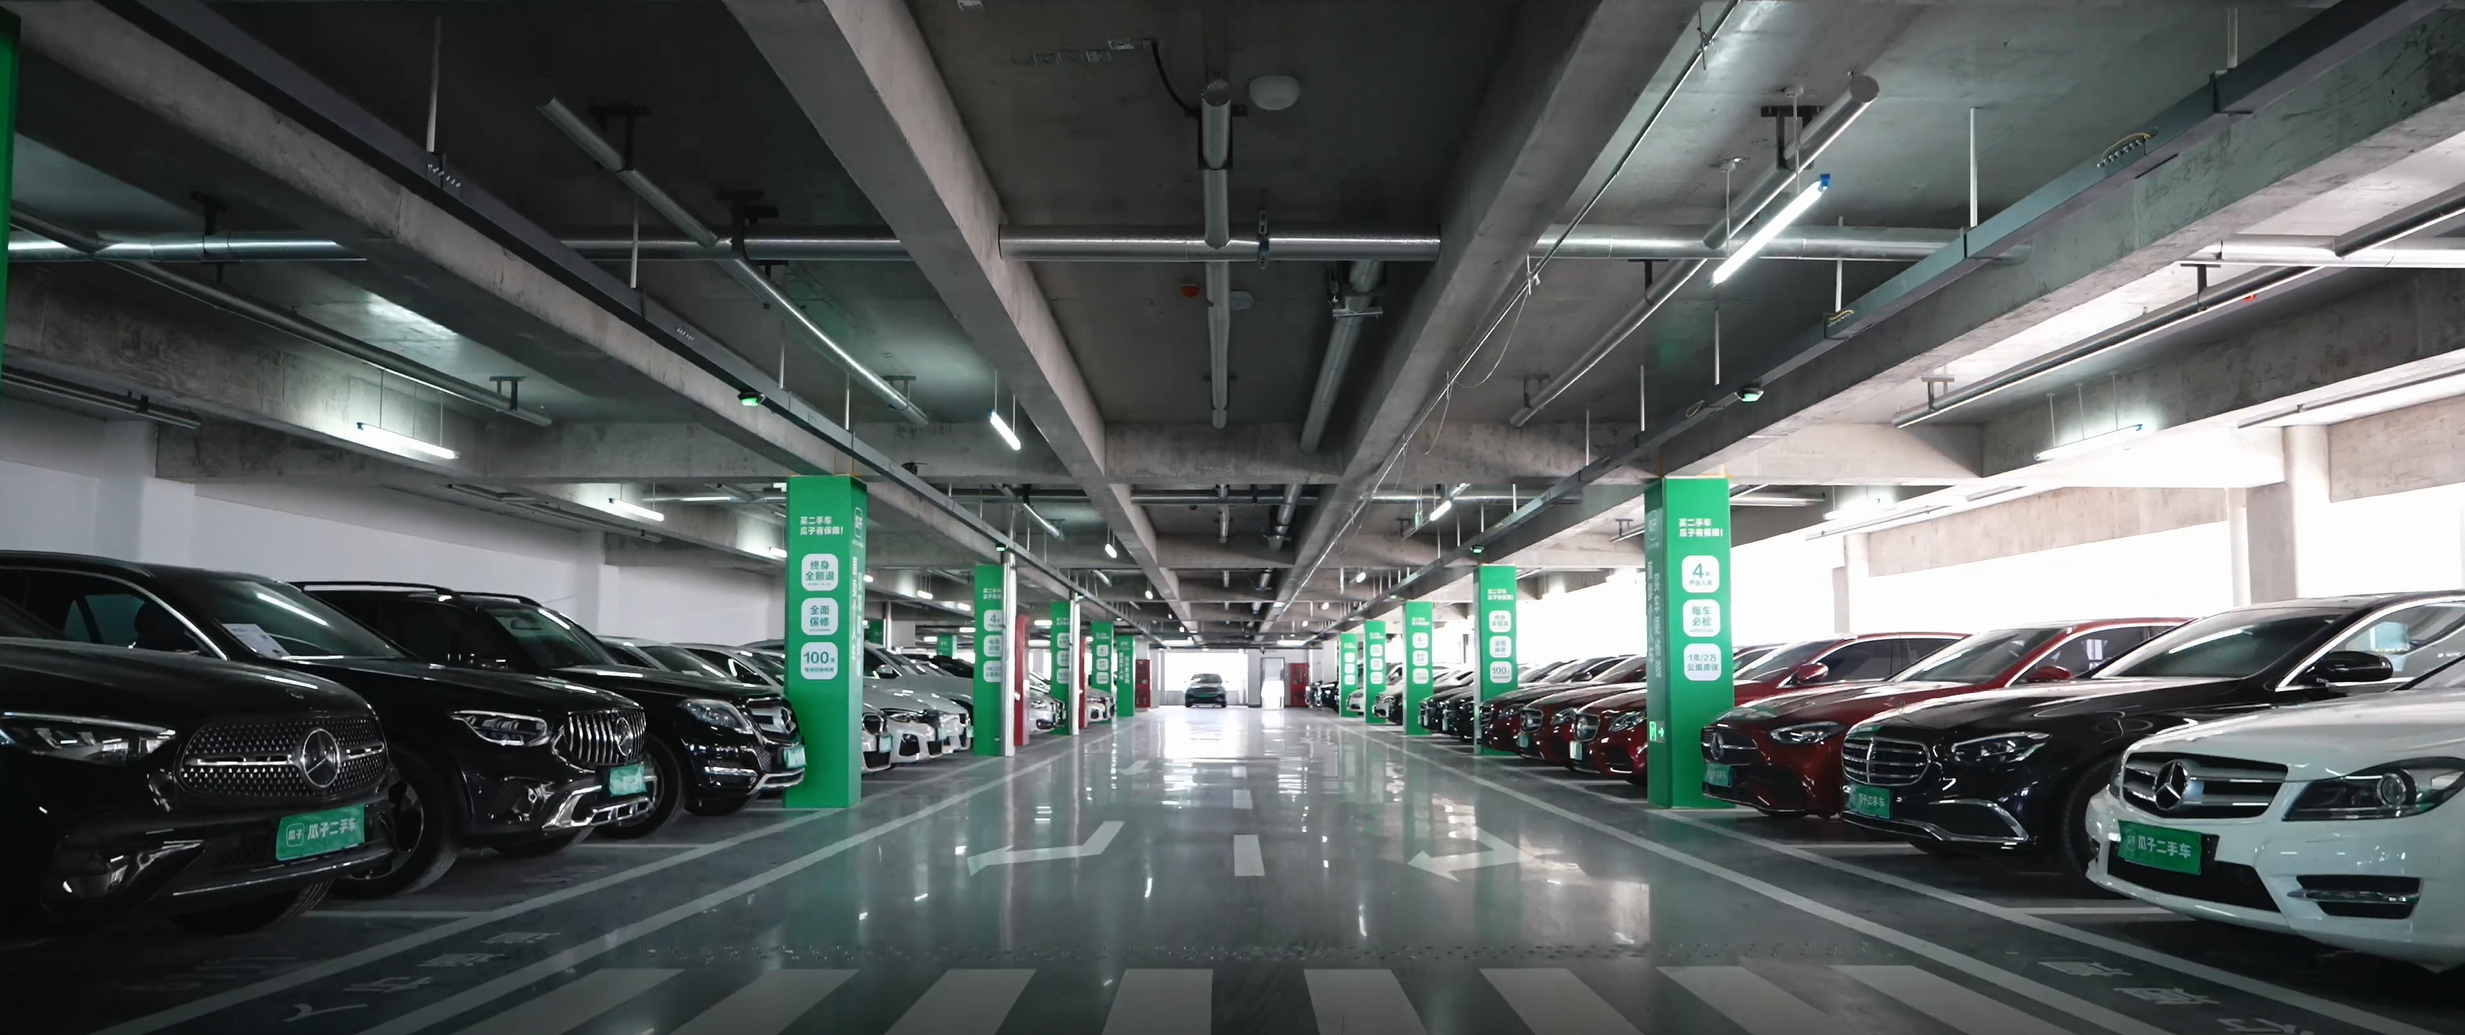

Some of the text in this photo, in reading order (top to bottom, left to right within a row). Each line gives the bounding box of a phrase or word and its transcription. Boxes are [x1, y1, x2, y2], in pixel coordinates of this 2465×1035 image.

[810, 560, 829, 570] 终身
[806, 571, 835, 581] 全额退
[810, 605, 830, 615] 全面
[1692, 606, 1712, 616] 每车
[810, 617, 830, 627] 保修
[1692, 617, 1712, 627] 必检
[1688, 653, 1717, 662] 1年/2万
[307, 817, 356, 840] 瓜子二手车
[288, 829, 304, 841] 瓜子
[2137, 835, 2191, 859] 瓜子二手车
